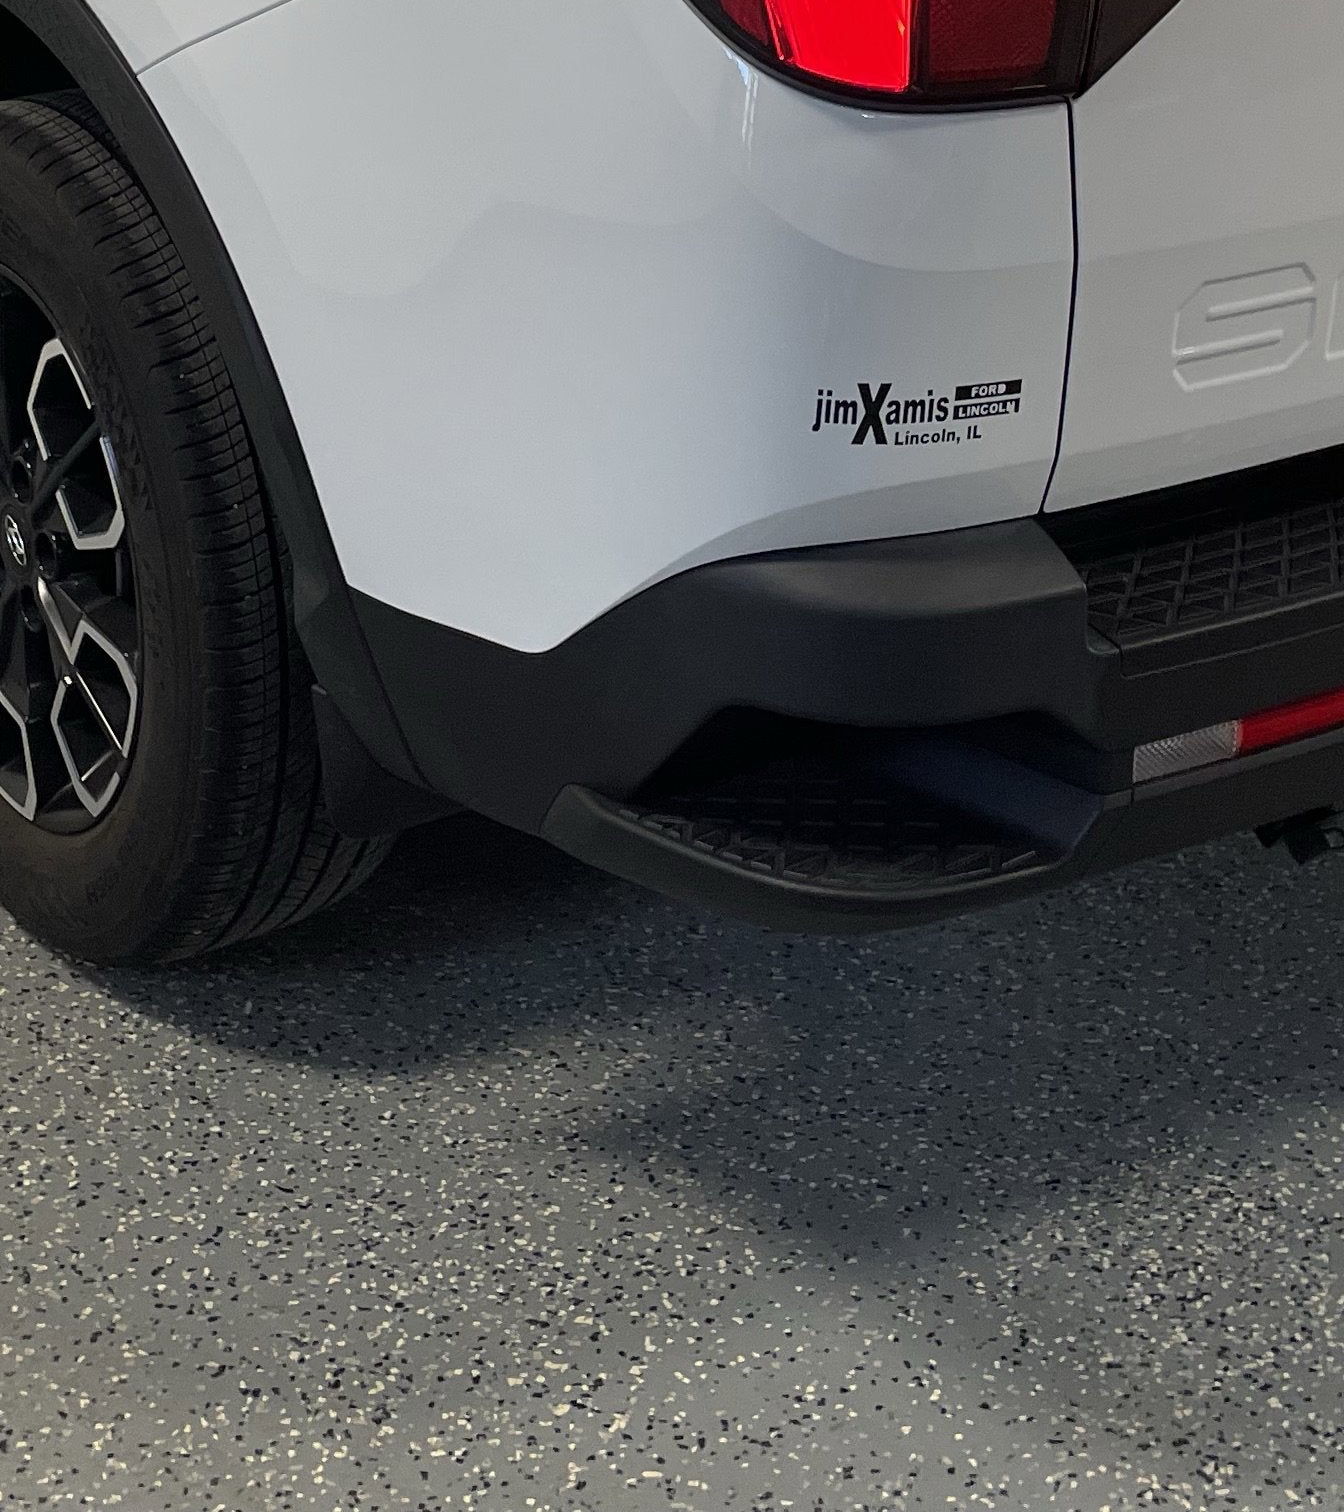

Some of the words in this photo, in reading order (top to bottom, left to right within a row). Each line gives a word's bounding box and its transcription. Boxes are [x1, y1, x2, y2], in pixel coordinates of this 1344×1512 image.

[970, 383, 1007, 398] FORD
[958, 401, 1016, 418] LINCOLN
[894, 428, 961, 445] Lincoln,
[966, 425, 982, 440] IL
